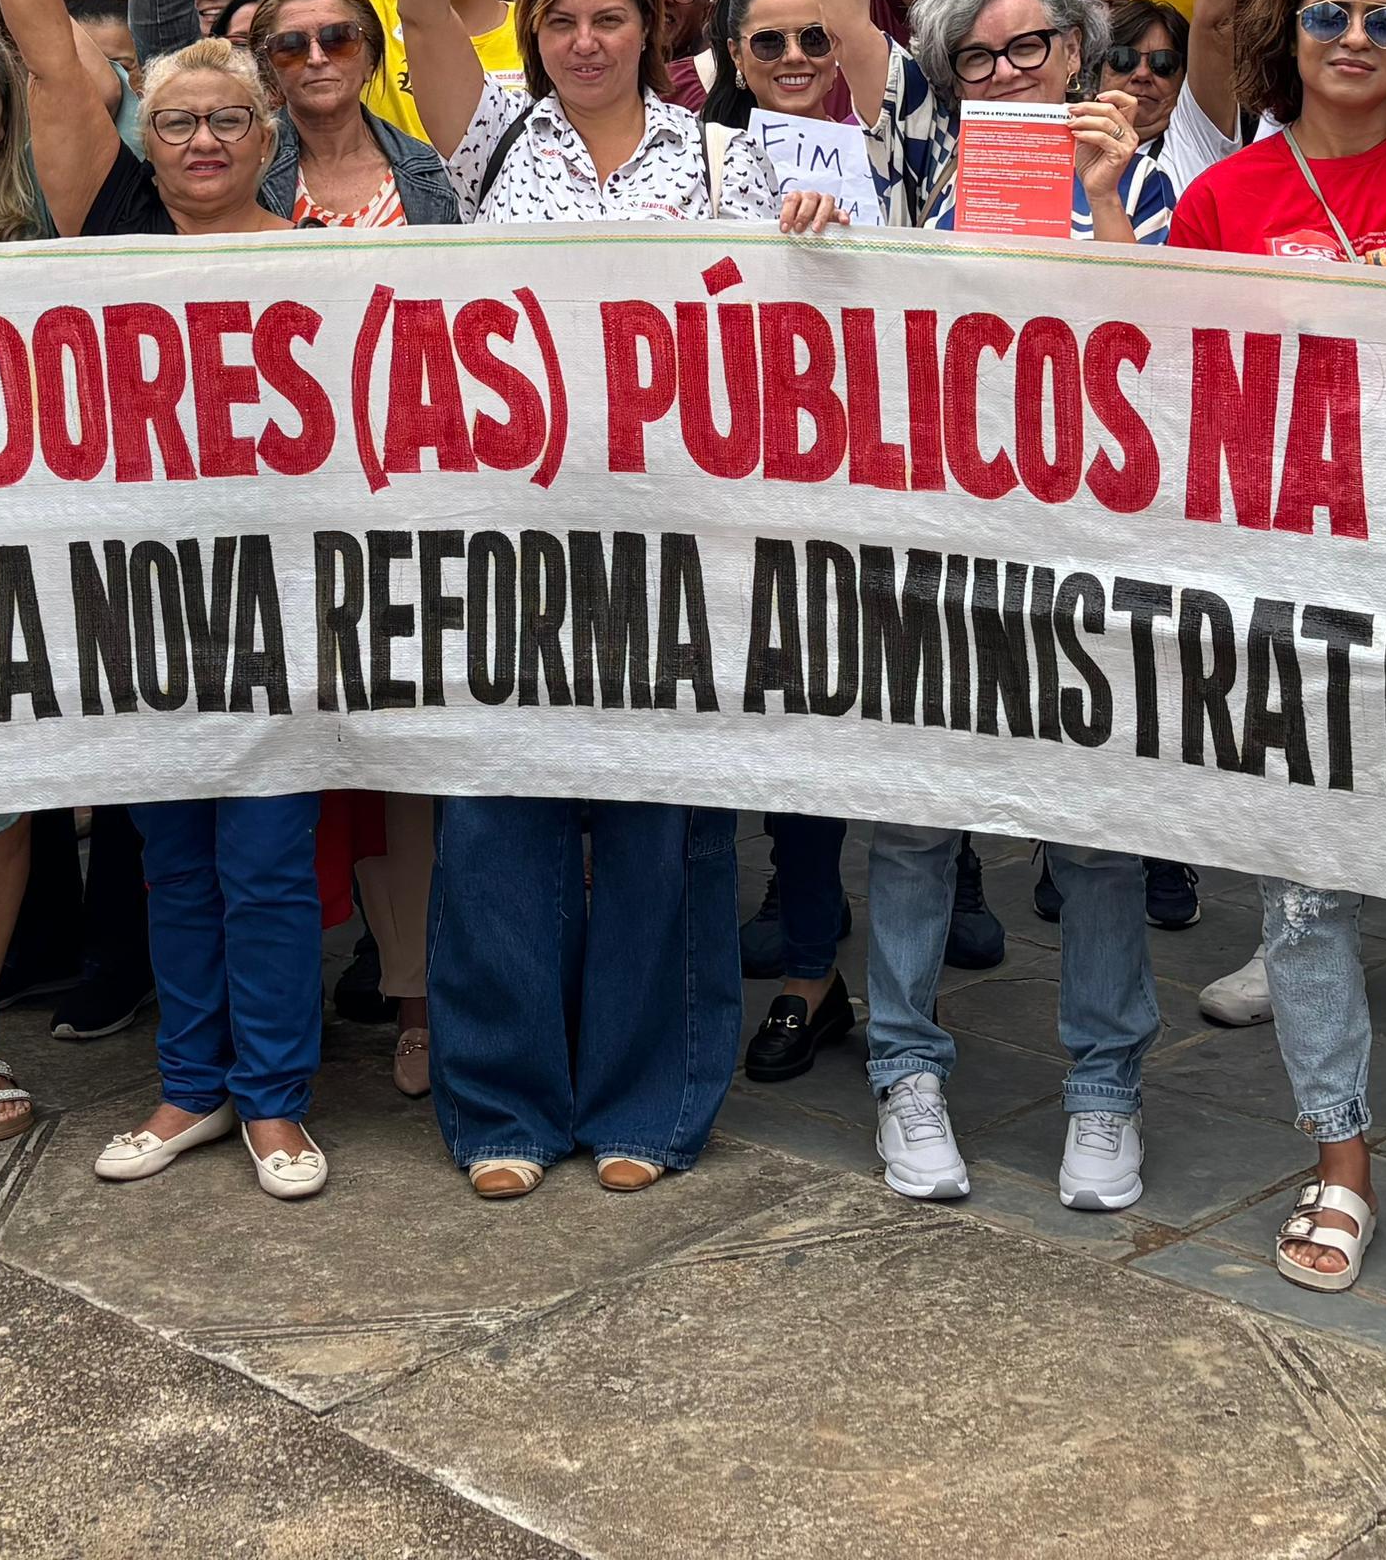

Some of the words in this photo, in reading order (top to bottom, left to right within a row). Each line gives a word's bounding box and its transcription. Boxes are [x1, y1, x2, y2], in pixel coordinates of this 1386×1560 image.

[352, 283, 566, 493] (AS)
[601, 258, 1161, 515] PÚBLICOS
[1185, 329, 1369, 541] NA
[69, 534, 291, 717] NOVA
[314, 529, 720, 714] REFORMA
